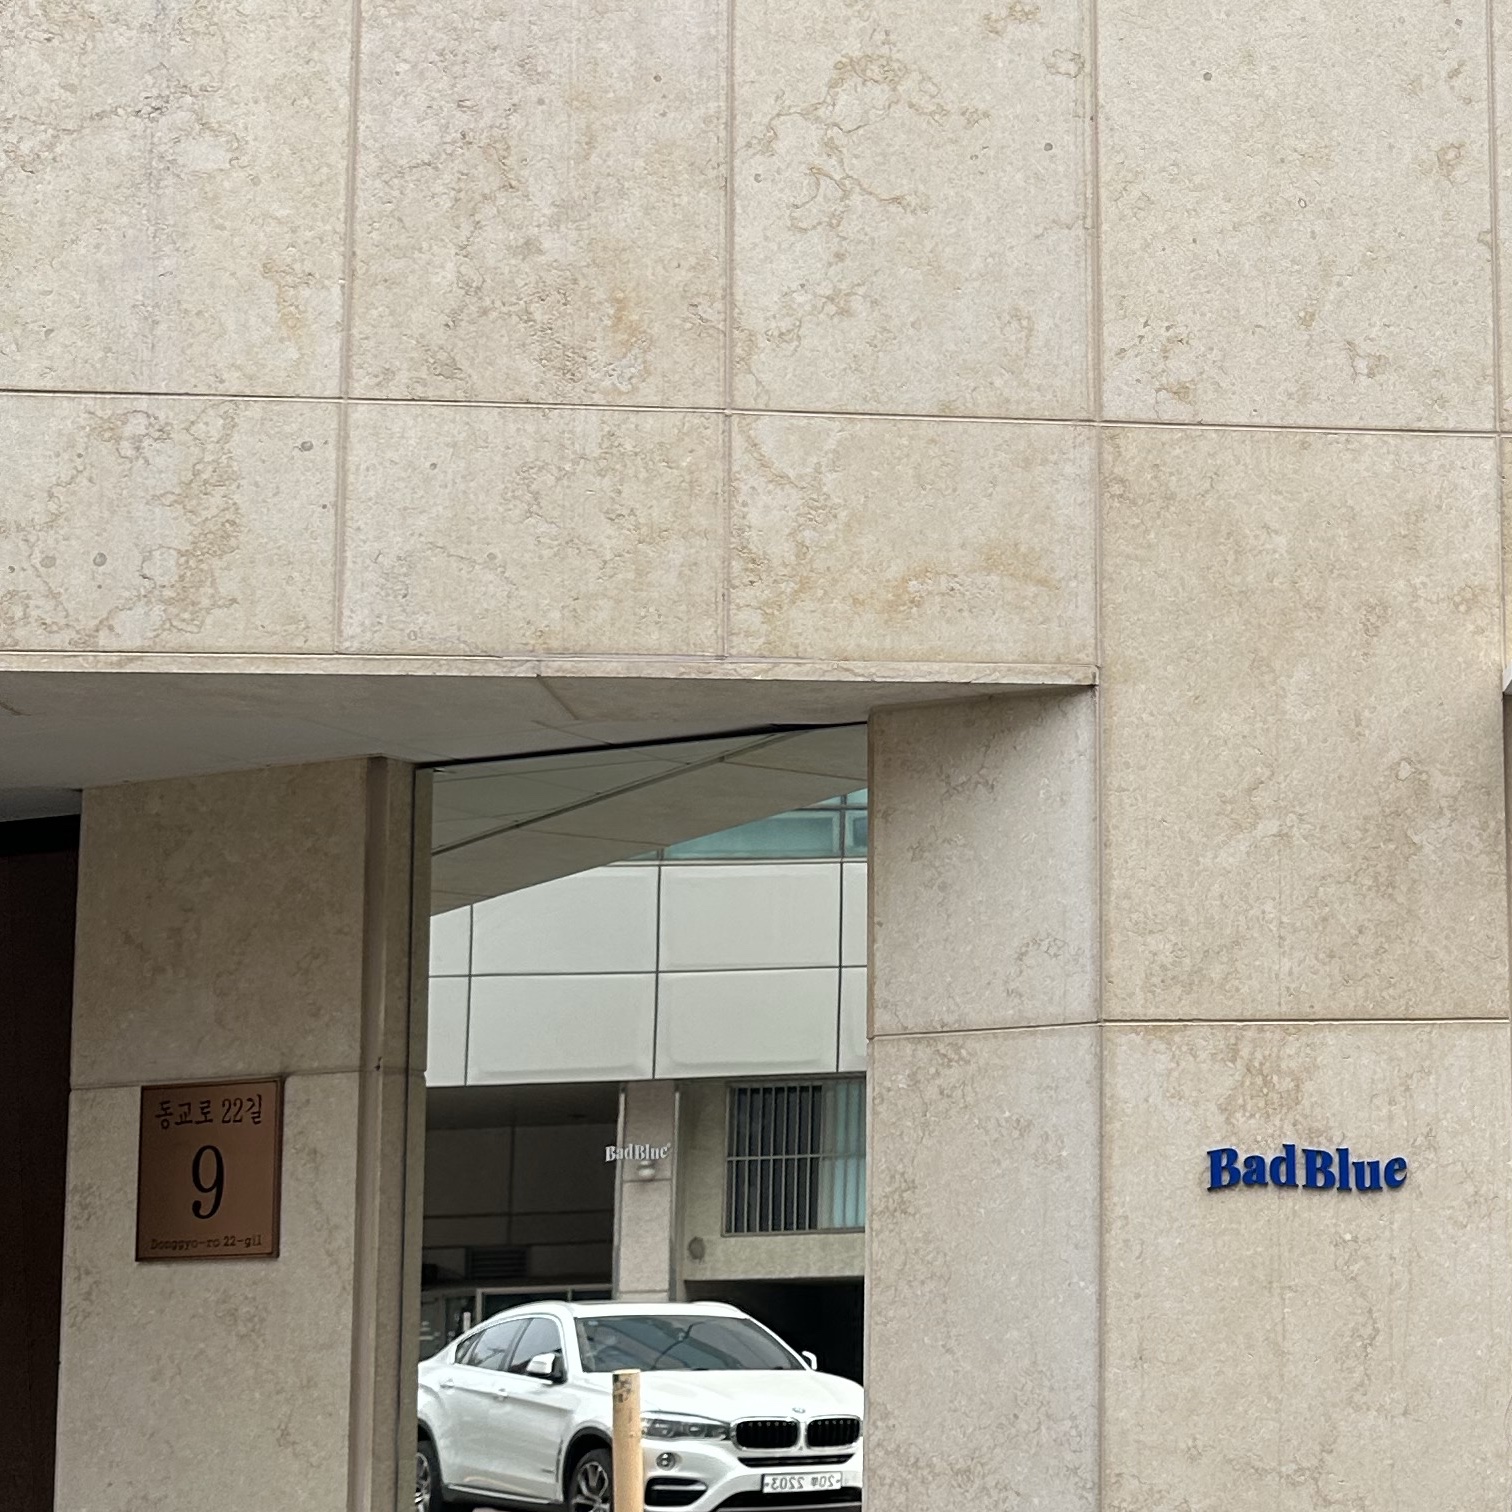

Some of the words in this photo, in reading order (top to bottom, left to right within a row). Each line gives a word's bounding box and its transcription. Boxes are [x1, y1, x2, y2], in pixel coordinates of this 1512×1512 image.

[155, 1100, 213, 1129] 동교로
[222, 1094, 262, 1125] 22길
[191, 1144, 225, 1220] 9
[1207, 1143, 1407, 1192] BadBlue
